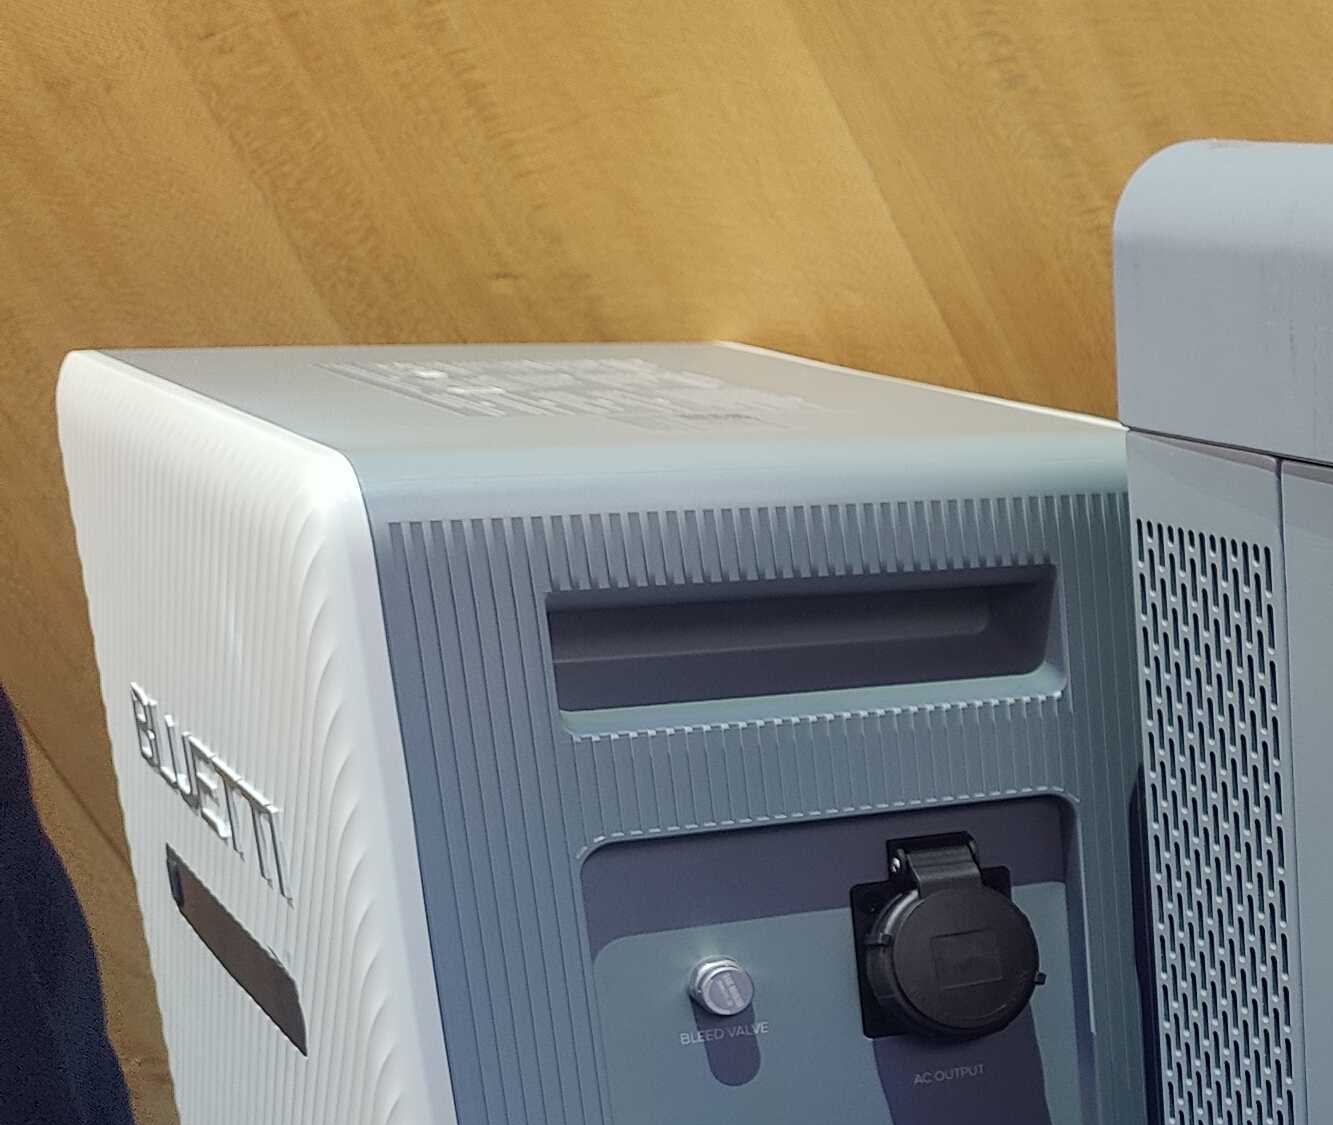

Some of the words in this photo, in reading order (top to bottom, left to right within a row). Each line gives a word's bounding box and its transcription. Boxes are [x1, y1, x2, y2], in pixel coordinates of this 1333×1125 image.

[680, 1027, 724, 1045] BLEED
[725, 1021, 769, 1039] VALVE
[912, 1071, 933, 1084] AC
[934, 1064, 984, 1082] OUTPUT
